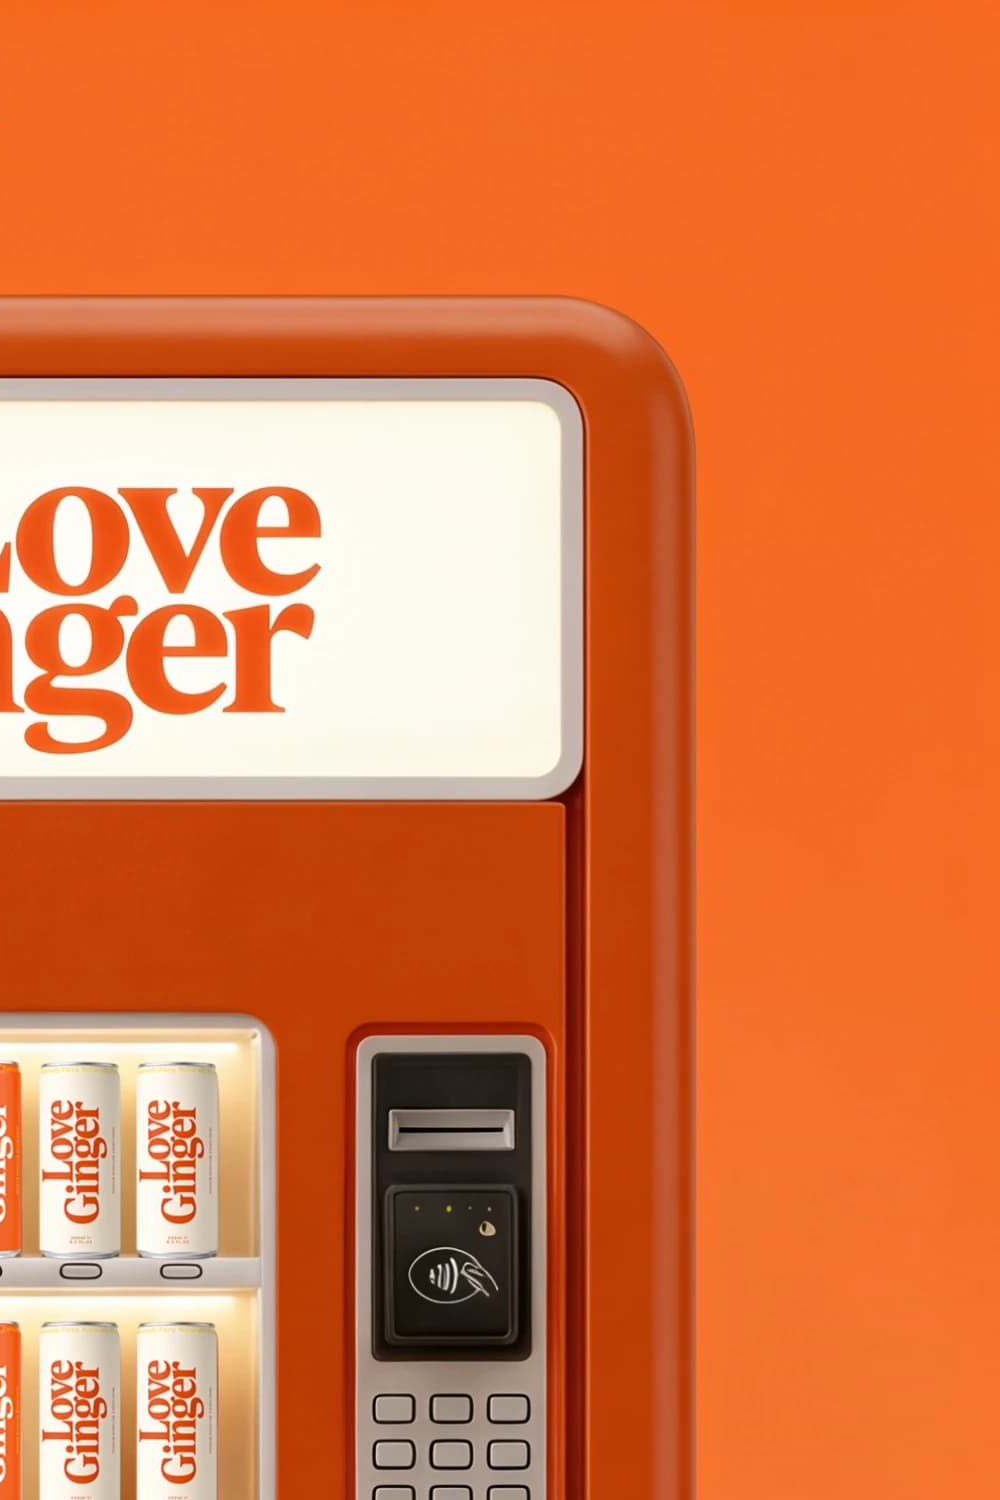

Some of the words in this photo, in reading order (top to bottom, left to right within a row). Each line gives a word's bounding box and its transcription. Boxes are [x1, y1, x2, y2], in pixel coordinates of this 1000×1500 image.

[42, 1100, 74, 1183] Love
[64, 1101, 108, 1225] Ginger
[139, 1100, 171, 1183] Love
[161, 1101, 205, 1225] Ginger
[42, 1360, 74, 1443] Love
[64, 1361, 108, 1485] Ginger
[139, 1360, 171, 1443] Love
[161, 1361, 205, 1485] Ginger
